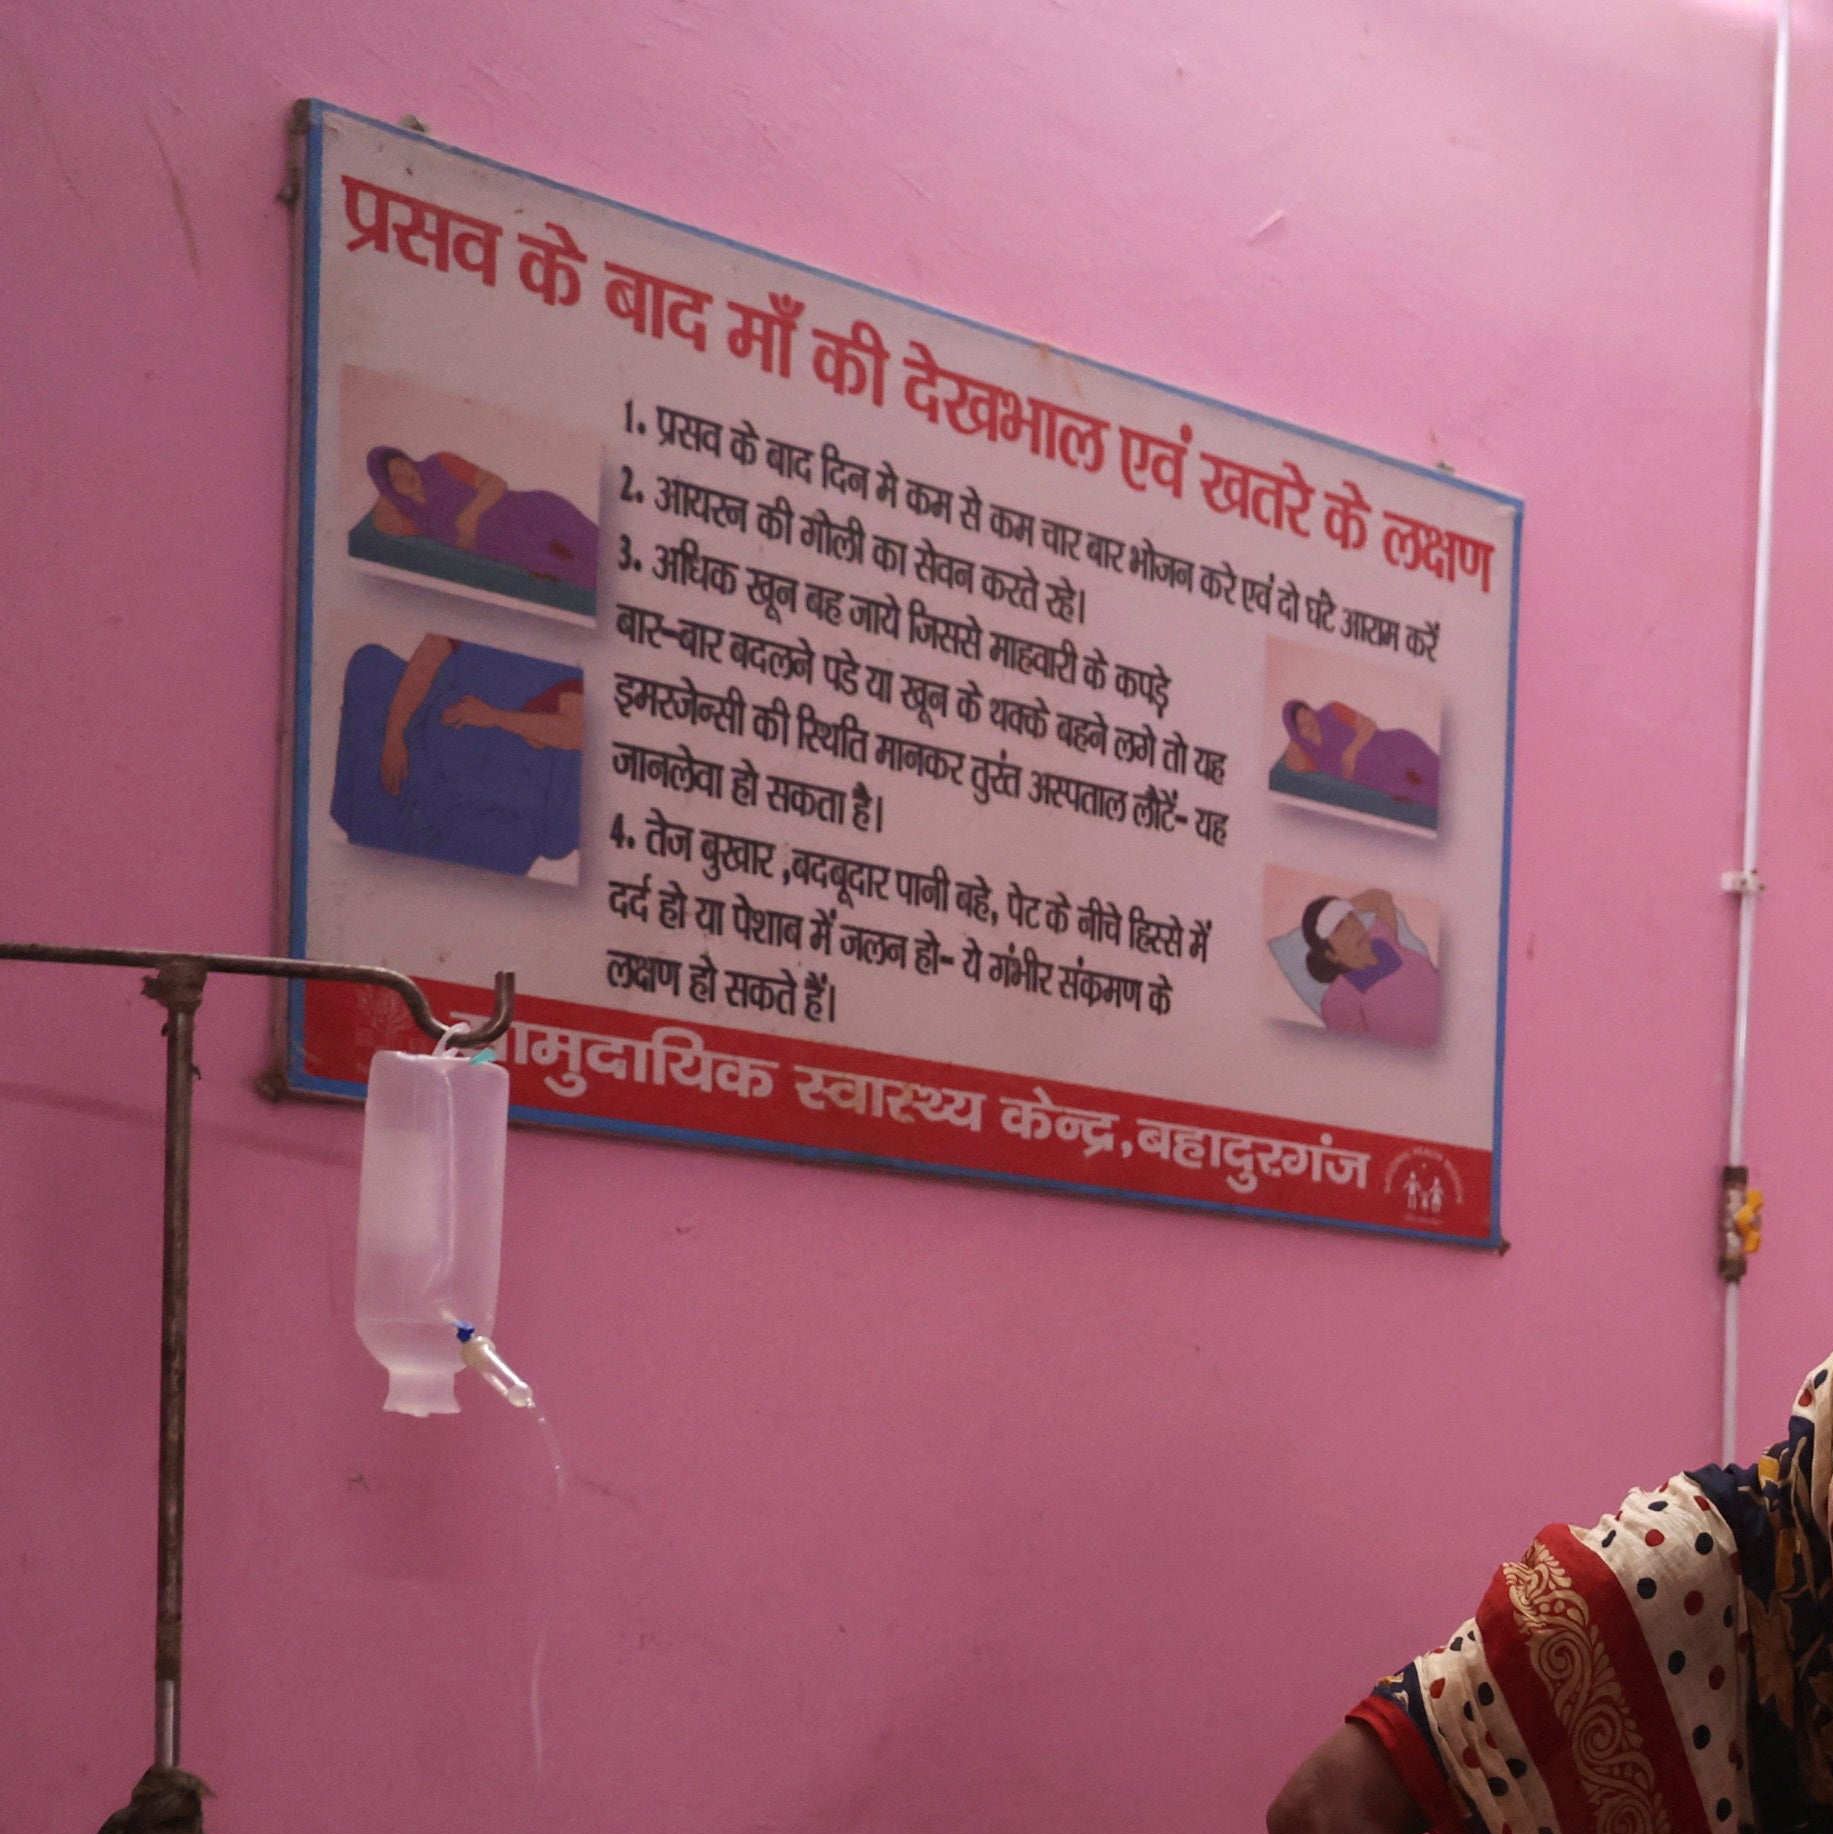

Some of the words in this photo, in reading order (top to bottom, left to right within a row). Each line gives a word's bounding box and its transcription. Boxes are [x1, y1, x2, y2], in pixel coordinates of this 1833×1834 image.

[341, 175, 503, 288] प्रसव
[517, 222, 588, 307] के
[604, 261, 713, 352] बाद
[726, 292, 806, 378] माँ
[812, 320, 889, 405] की
[902, 341, 1110, 474] देखभाल
[1119, 424, 1194, 499] एवं
[1199, 449, 1317, 539] खतरे
[1324, 481, 1374, 551] के
[1382, 509, 1494, 594] लक्षण
[619, 465, 645, 504] 2.
[757, 496, 794, 545] की
[800, 508, 866, 565] गोली
[872, 533, 909, 577] का
[914, 537, 975, 597] सेवन
[981, 566, 1039, 612] करते
[624, 400, 647, 435] 1.
[656, 405, 723, 458] प्रसव
[730, 420, 760, 465] के
[765, 437, 815, 484] बाद
[821, 442, 869, 501] दिन
[905, 479, 953, 524] कम
[959, 486, 984, 533] से
[990, 504, 1035, 548] कम
[1041, 518, 1082, 561] चार
[1086, 532, 1125, 573] बार
[1130, 538, 1194, 594] भोजन
[1200, 560, 1237, 605] करे
[1242, 573, 1275, 615] एवं
[1277, 580, 1300, 623] दो
[1341, 607, 1400, 651] आराम
[1405, 620, 1441, 663] करें
[617, 533, 642, 572] 3.
[652, 537, 739, 596] अधिक
[745, 566, 799, 624] खून
[805, 583, 845, 627] बह
[849, 593, 902, 640] जाये
[908, 598, 982, 661] जिससे
[989, 631, 1077, 686] माहवारी
[1083, 647, 1108, 691] के
[611, 741, 724, 800] जानलेवा
[730, 757, 759, 807] हो
[766, 775, 848, 825] सकता
[614, 672, 746, 737] इमरजेन्सी
[751, 696, 791, 747] की
[795, 703, 870, 764] स्थिति
[874, 733, 966, 786] मानकर
[971, 749, 1023, 805] तुरंत
[1027, 769, 1128, 823] अस्पताल
[1195, 806, 1229, 847] यह
[729, 632, 815, 686] बदलने
[865, 664, 894, 704] या
[900, 673, 950, 730] खून
[957, 679, 983, 724] के
[1056, 711, 1108, 756] बहने
[1114, 723, 1156, 768] लगे
[1162, 731, 1189, 775] तो
[1193, 746, 1228, 786] यह
[608, 873, 652, 923] दर्द
[658, 880, 688, 930] हो
[695, 897, 726, 936] या
[732, 892, 803, 950] पेशाब
[810, 908, 838, 956] में
[840, 923, 909, 970] जलन
[962, 936, 983, 983] ये
[988, 942, 1054, 997] गंभीर
[1057, 955, 1143, 1013] संक्रमण
[1147, 973, 1173, 1017] के
[609, 812, 636, 850] 4.
[645, 807, 695, 862] तेज
[700, 829, 777, 882] बुखार
[895, 864, 951, 913] पानी
[1008, 881, 1042, 930] पेट
[1045, 892, 1072, 934] के
[1077, 897, 1122, 946] नीचे
[1129, 905, 1184, 958] हिस्से
[1189, 918, 1213, 964] में
[607, 949, 682, 998] लक्षण
[689, 955, 718, 1003] हो
[724, 968, 797, 1016] सकते
[794, 1065, 987, 1132] स्वास्थ्य
